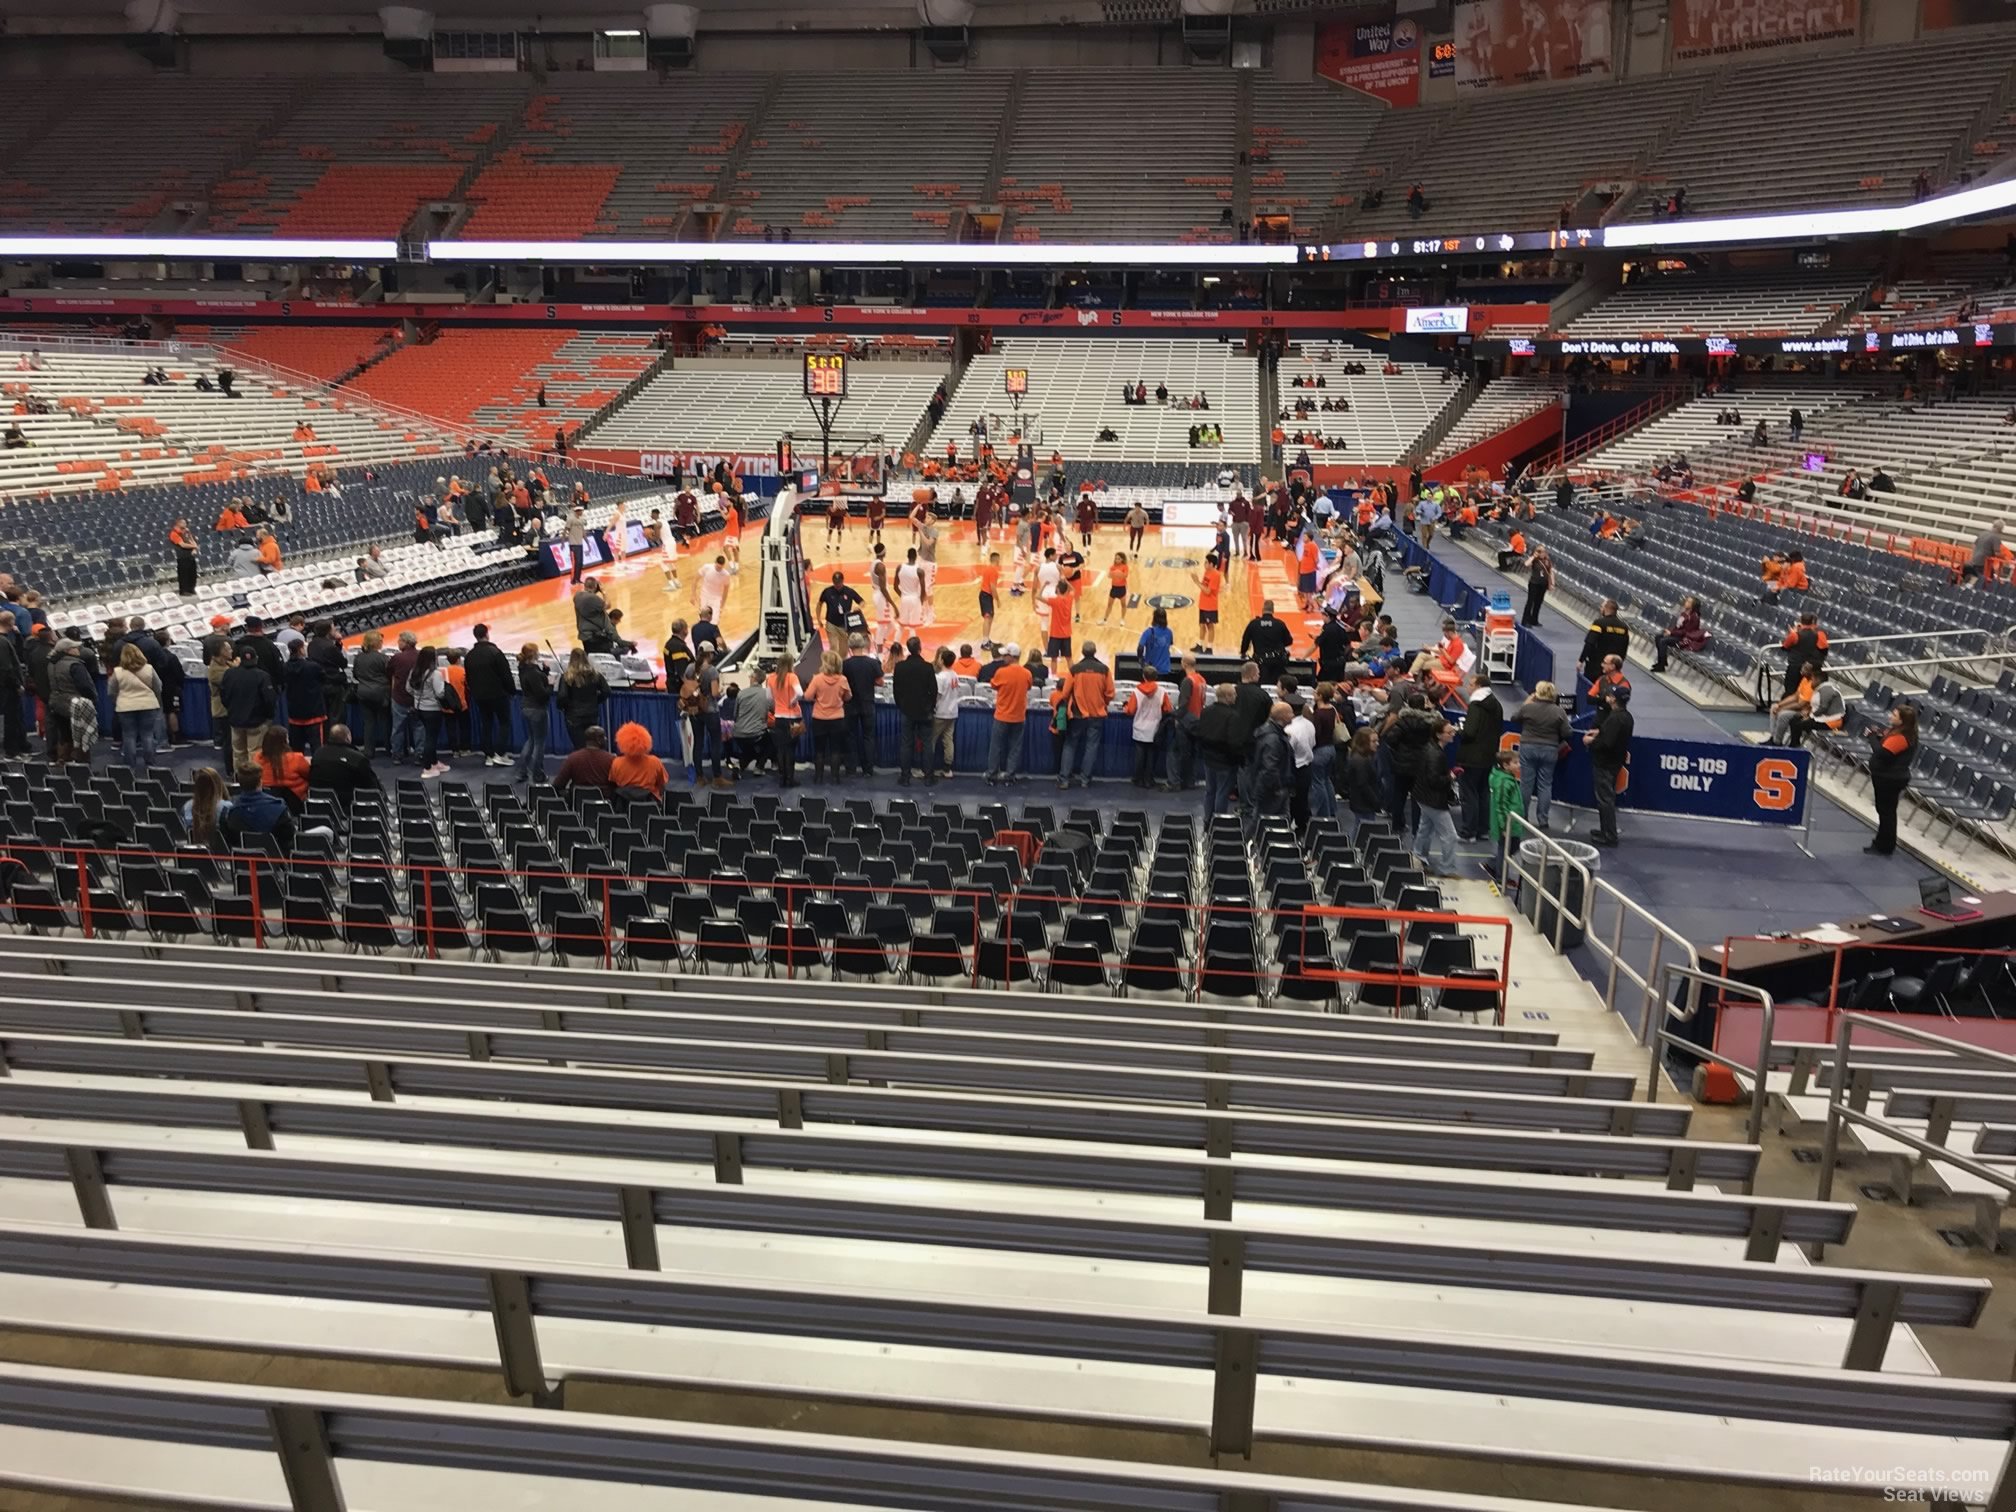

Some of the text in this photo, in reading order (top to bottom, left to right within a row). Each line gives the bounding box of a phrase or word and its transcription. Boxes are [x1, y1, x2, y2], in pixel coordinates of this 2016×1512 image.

[1356, 23, 1391, 40] United
[1368, 38, 1390, 53] Way
[1745, 35, 1802, 51] FOUNDATION
[1804, 27, 1855, 42] CHAMPION
[1391, 242, 1399, 254] 0
[1413, 239, 1460, 254] 51:17 1ST
[1476, 237, 1485, 250] 0
[547, 305, 556, 318] S
[824, 308, 833, 322] S
[1112, 311, 1121, 325] S
[1509, 340, 1530, 348] STOP
[1561, 341, 1679, 353] Don't Drive. Get a Ride.
[1705, 338, 1730, 347] STOP
[813, 370, 838, 392] 30
[1659, 754, 1728, 775] 108-109
[1669, 773, 1713, 793] ONLY
[1753, 757, 1798, 811] S
